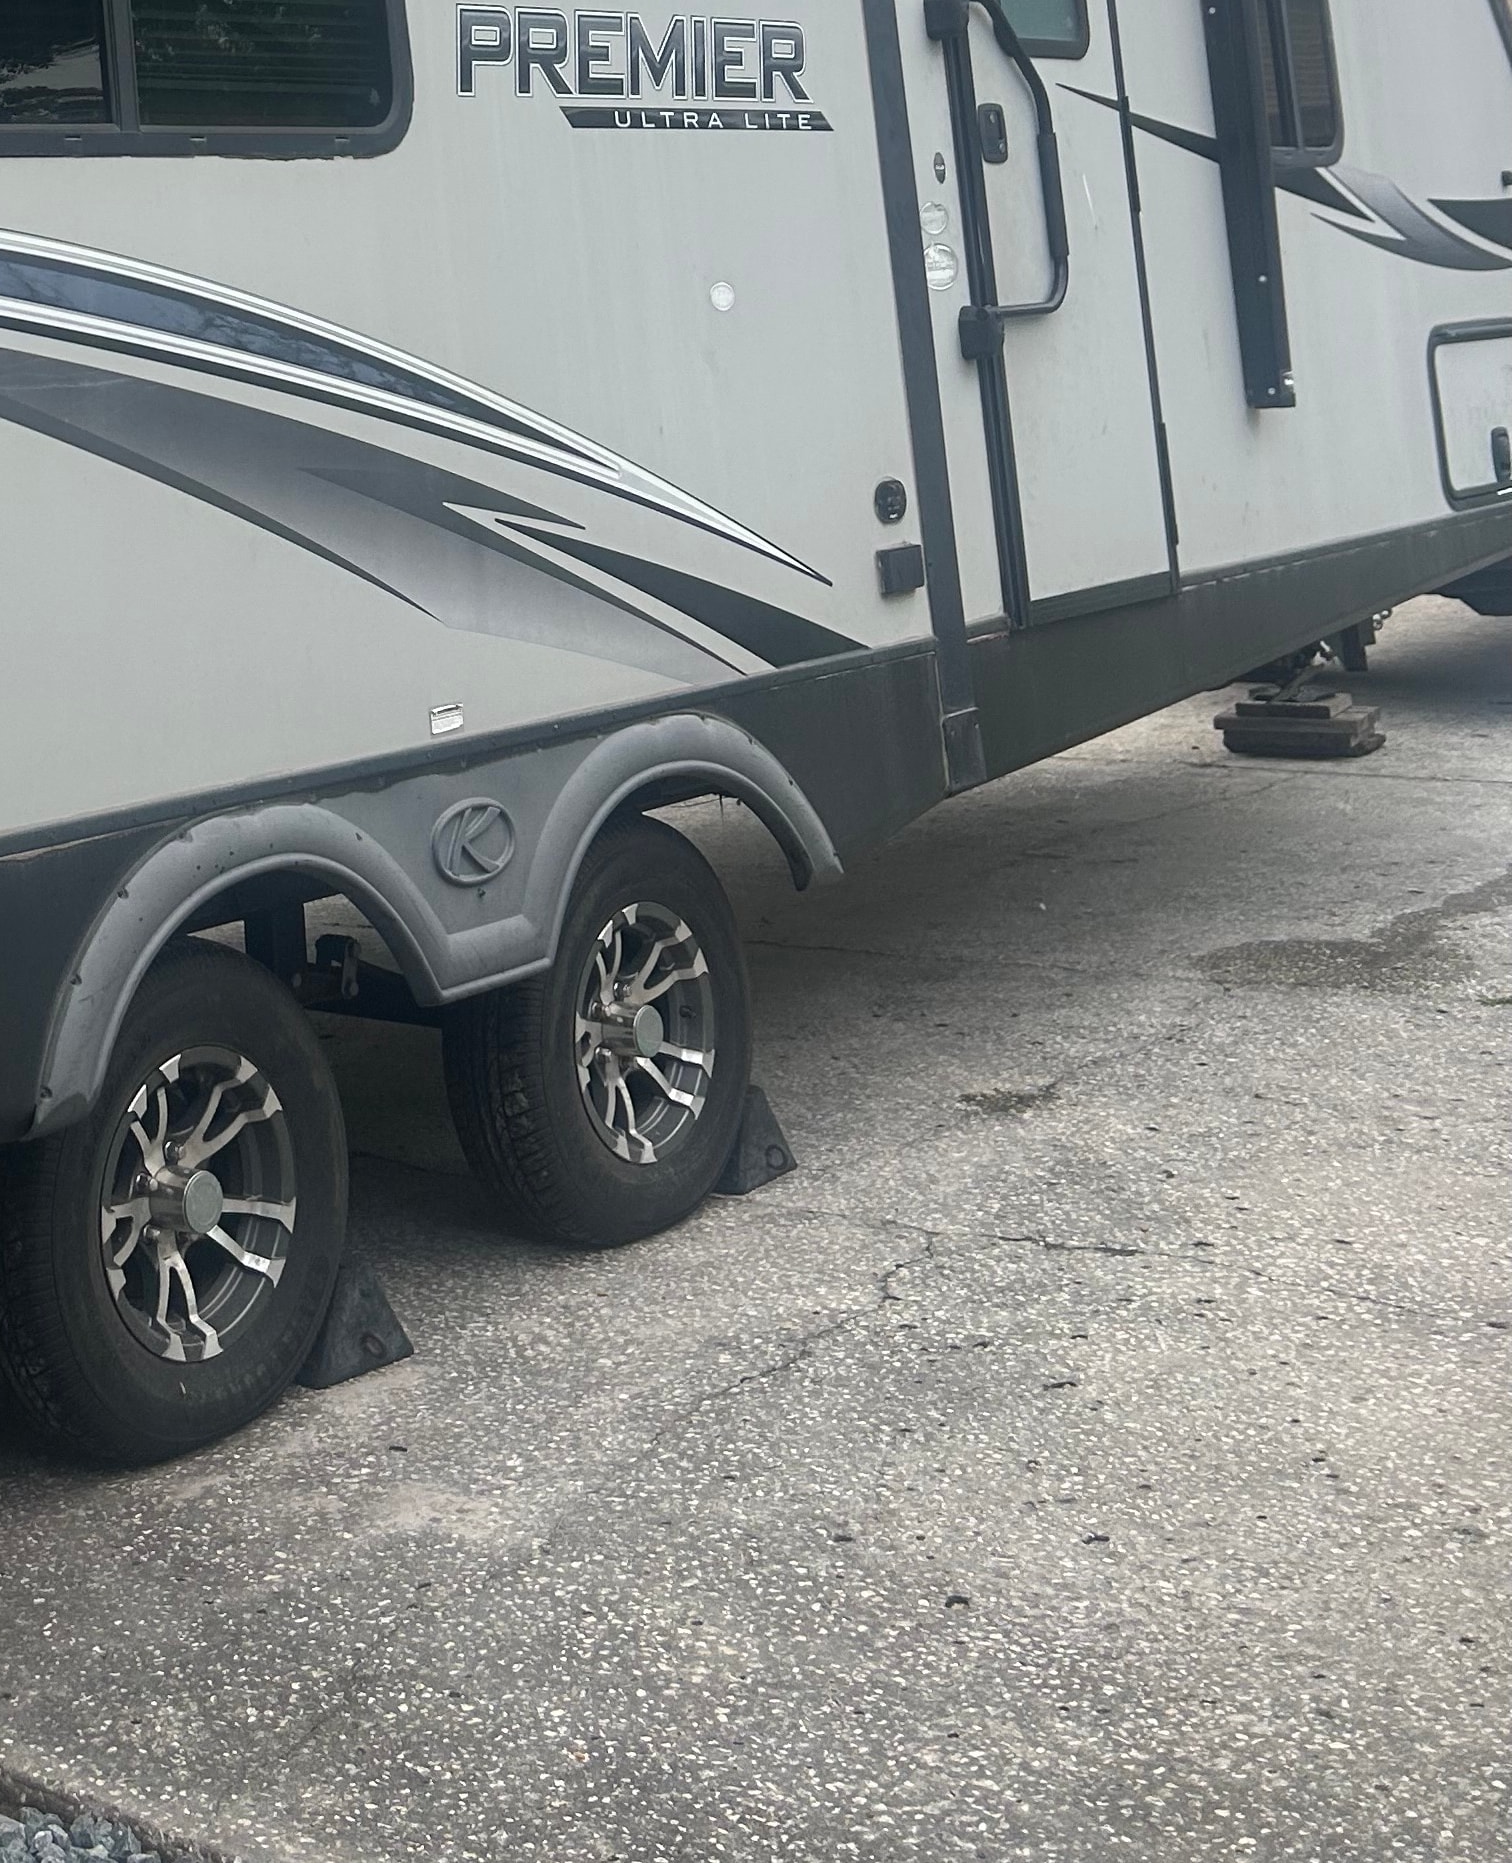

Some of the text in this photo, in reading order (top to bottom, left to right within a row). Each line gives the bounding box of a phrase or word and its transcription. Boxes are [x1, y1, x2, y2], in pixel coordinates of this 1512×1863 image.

[455, 3, 814, 103] PREMIER
[614, 110, 813, 130] ULTRA LITE
[446, 806, 501, 877] K
